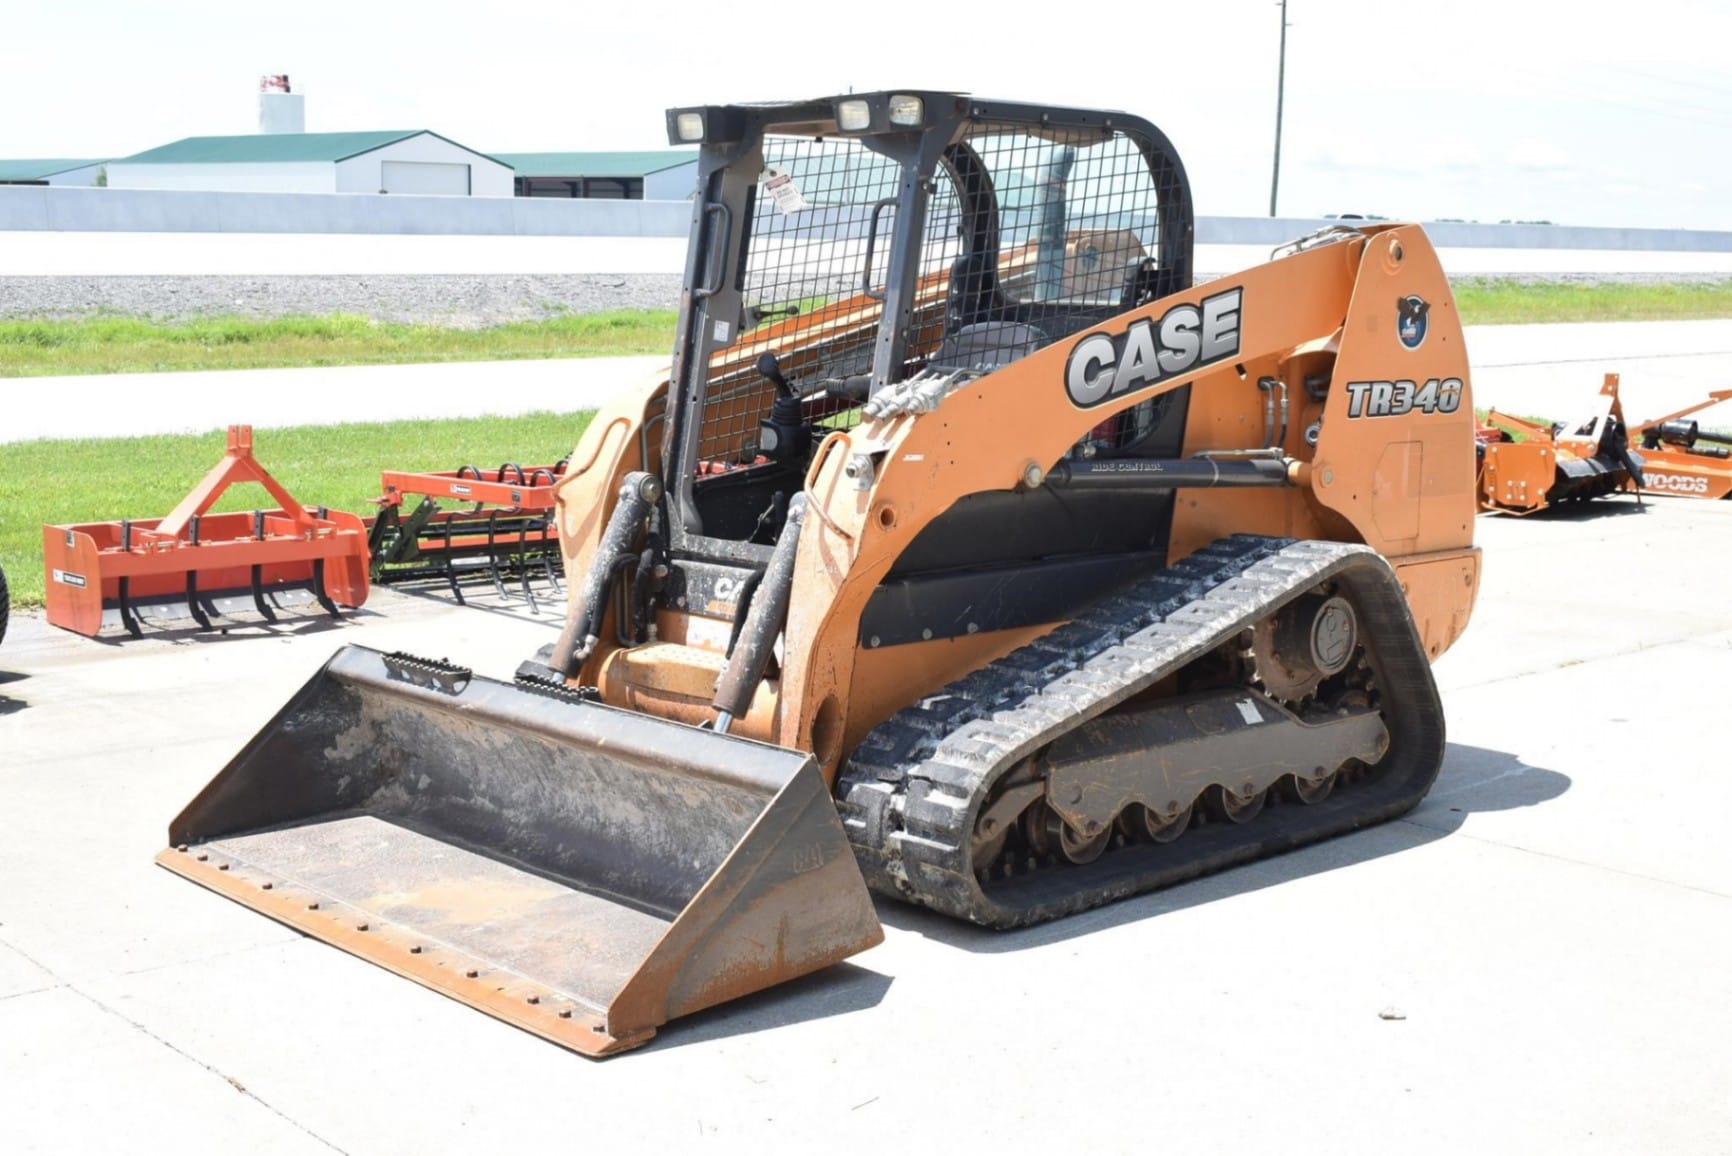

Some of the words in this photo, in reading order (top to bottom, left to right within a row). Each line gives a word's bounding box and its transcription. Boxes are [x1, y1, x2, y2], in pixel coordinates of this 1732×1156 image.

[1066, 287, 1241, 406] CASE
[1346, 377, 1463, 418] TR340
[1641, 472, 1709, 493] WOODS
